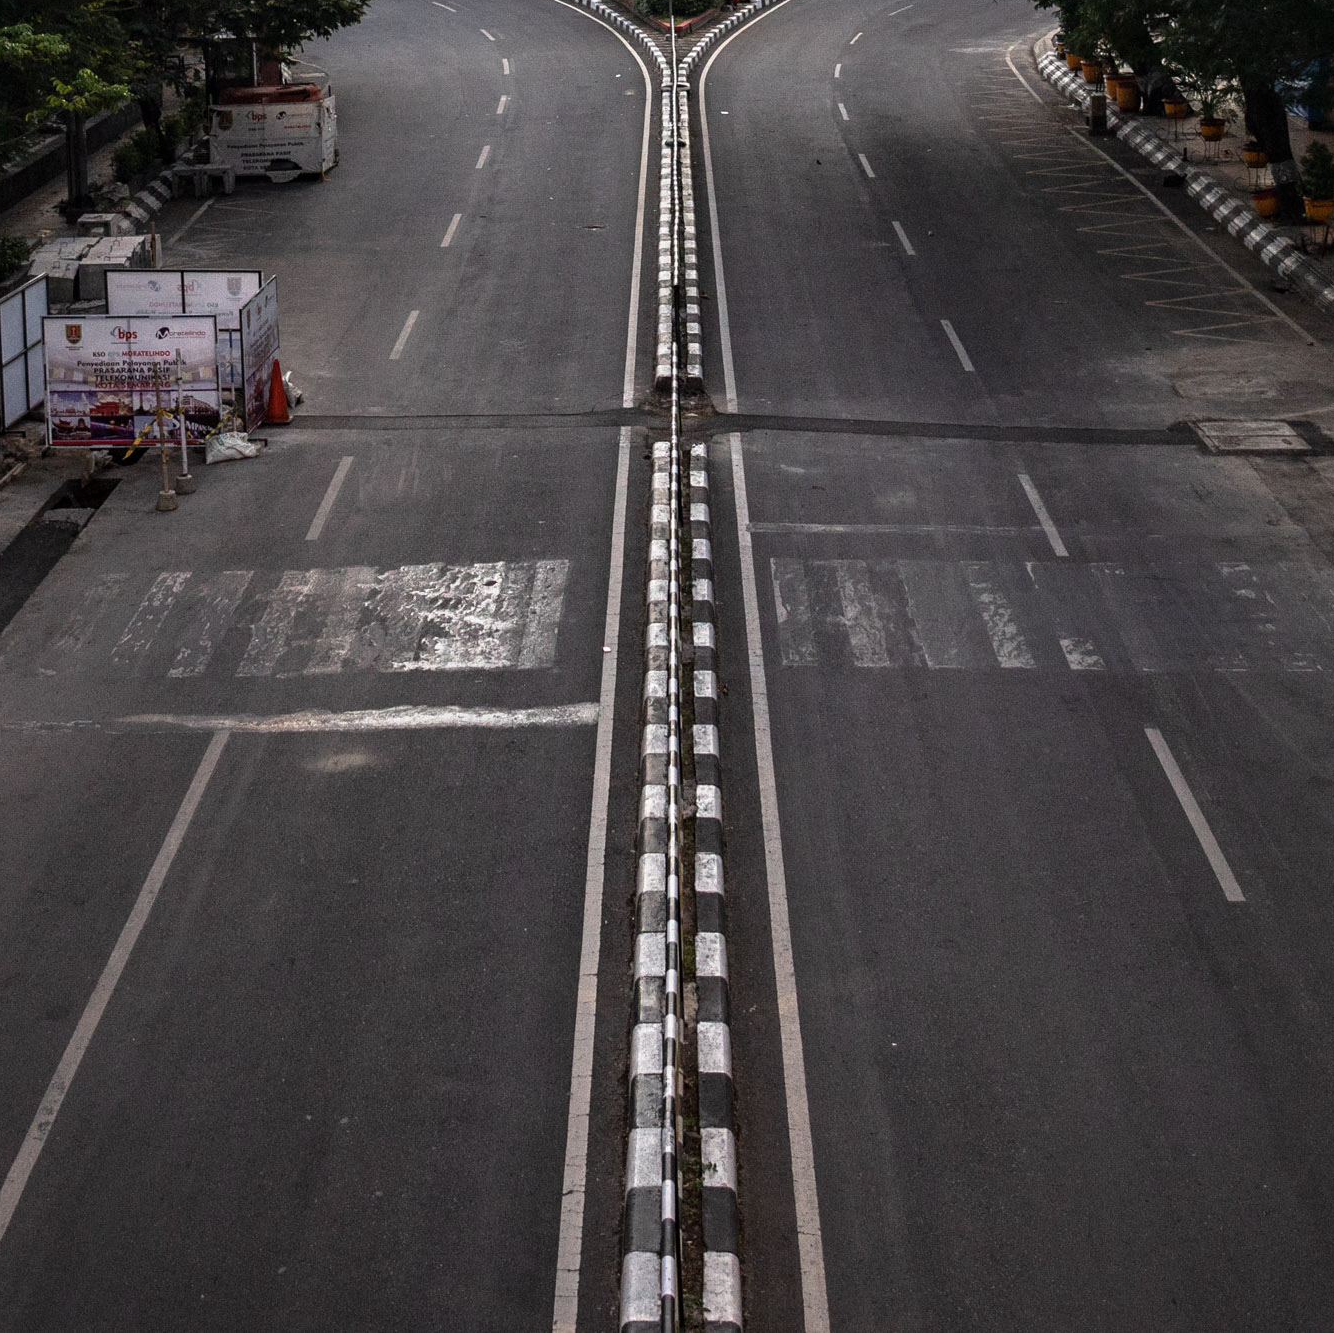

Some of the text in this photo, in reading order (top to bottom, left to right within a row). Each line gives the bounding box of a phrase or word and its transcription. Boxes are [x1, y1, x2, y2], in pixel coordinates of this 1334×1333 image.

[117, 327, 138, 341] bps
[77, 360, 120, 368] Penyediaan
[122, 360, 161, 368] Pelayanan
